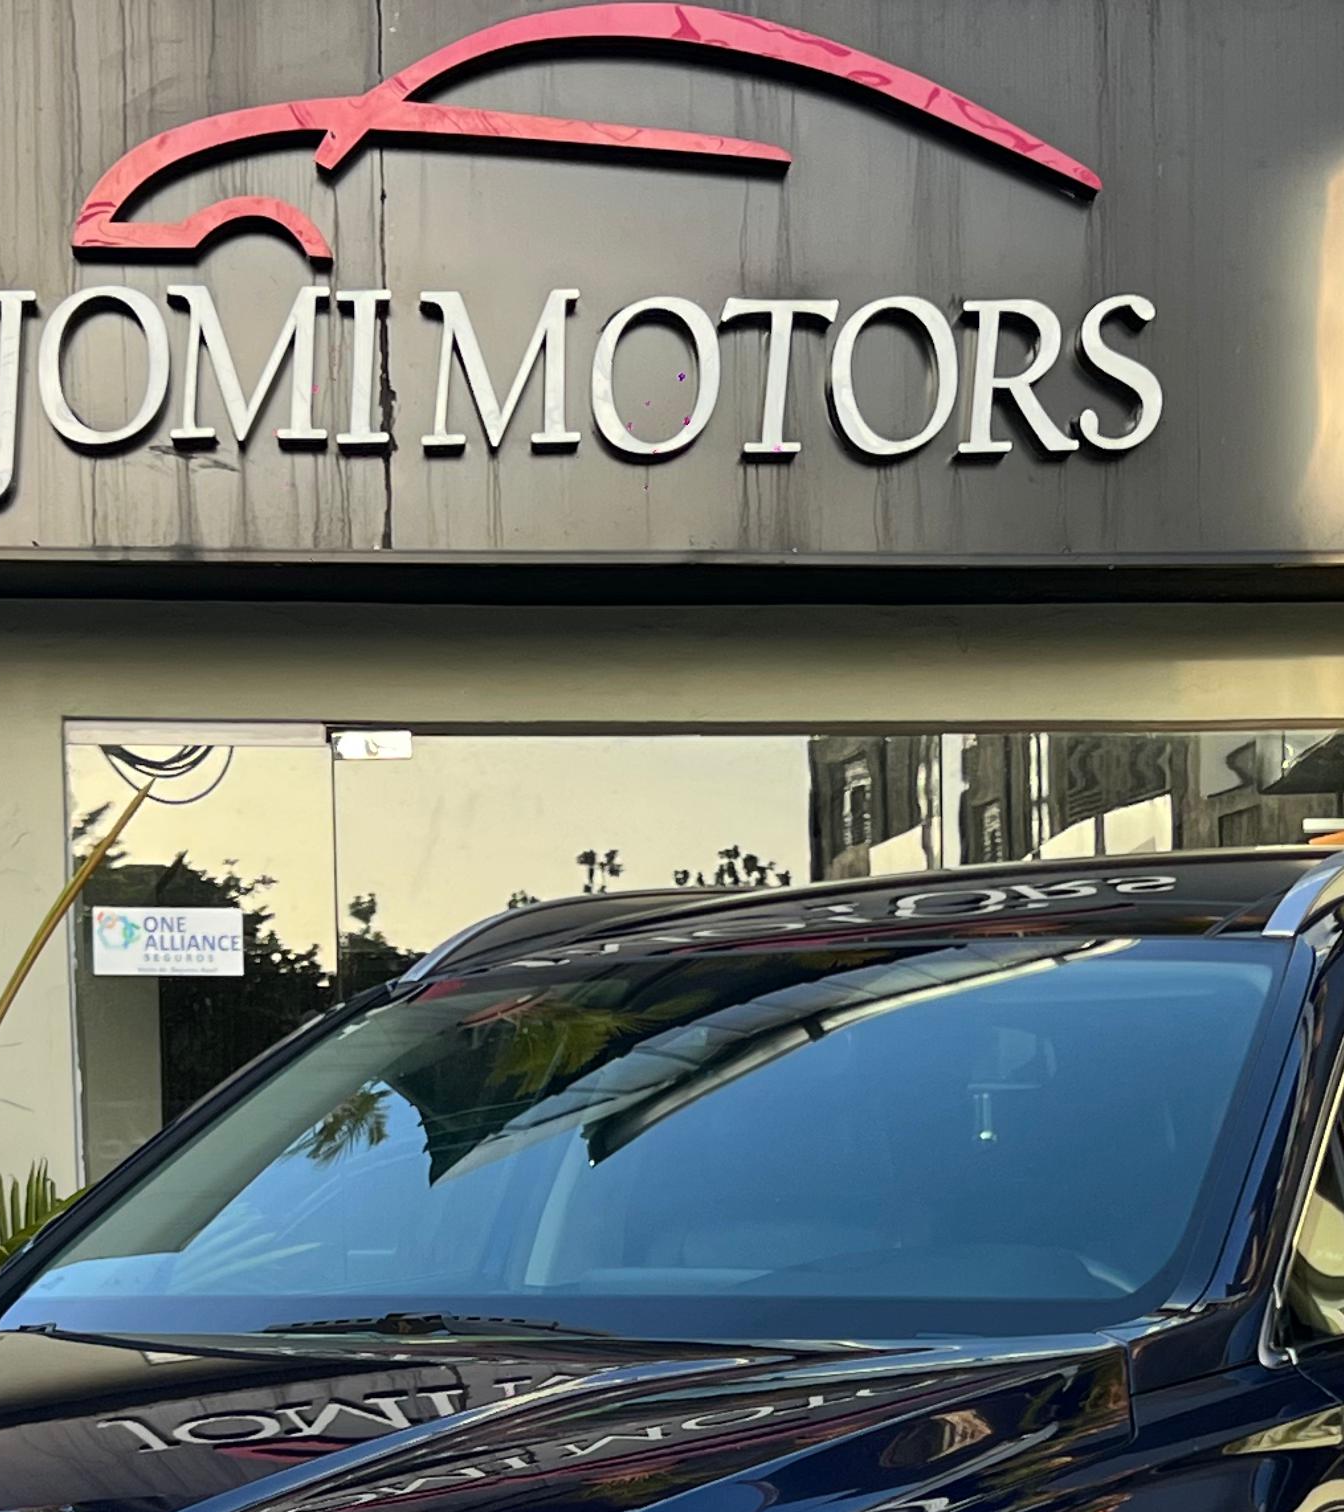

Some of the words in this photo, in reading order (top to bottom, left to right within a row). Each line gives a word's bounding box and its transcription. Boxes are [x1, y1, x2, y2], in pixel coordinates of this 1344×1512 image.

[419, 287, 1165, 460] MOTORS
[143, 916, 187, 933] ONE
[144, 934, 241, 951] ALLIANCE
[143, 953, 215, 963] SEGUROS
